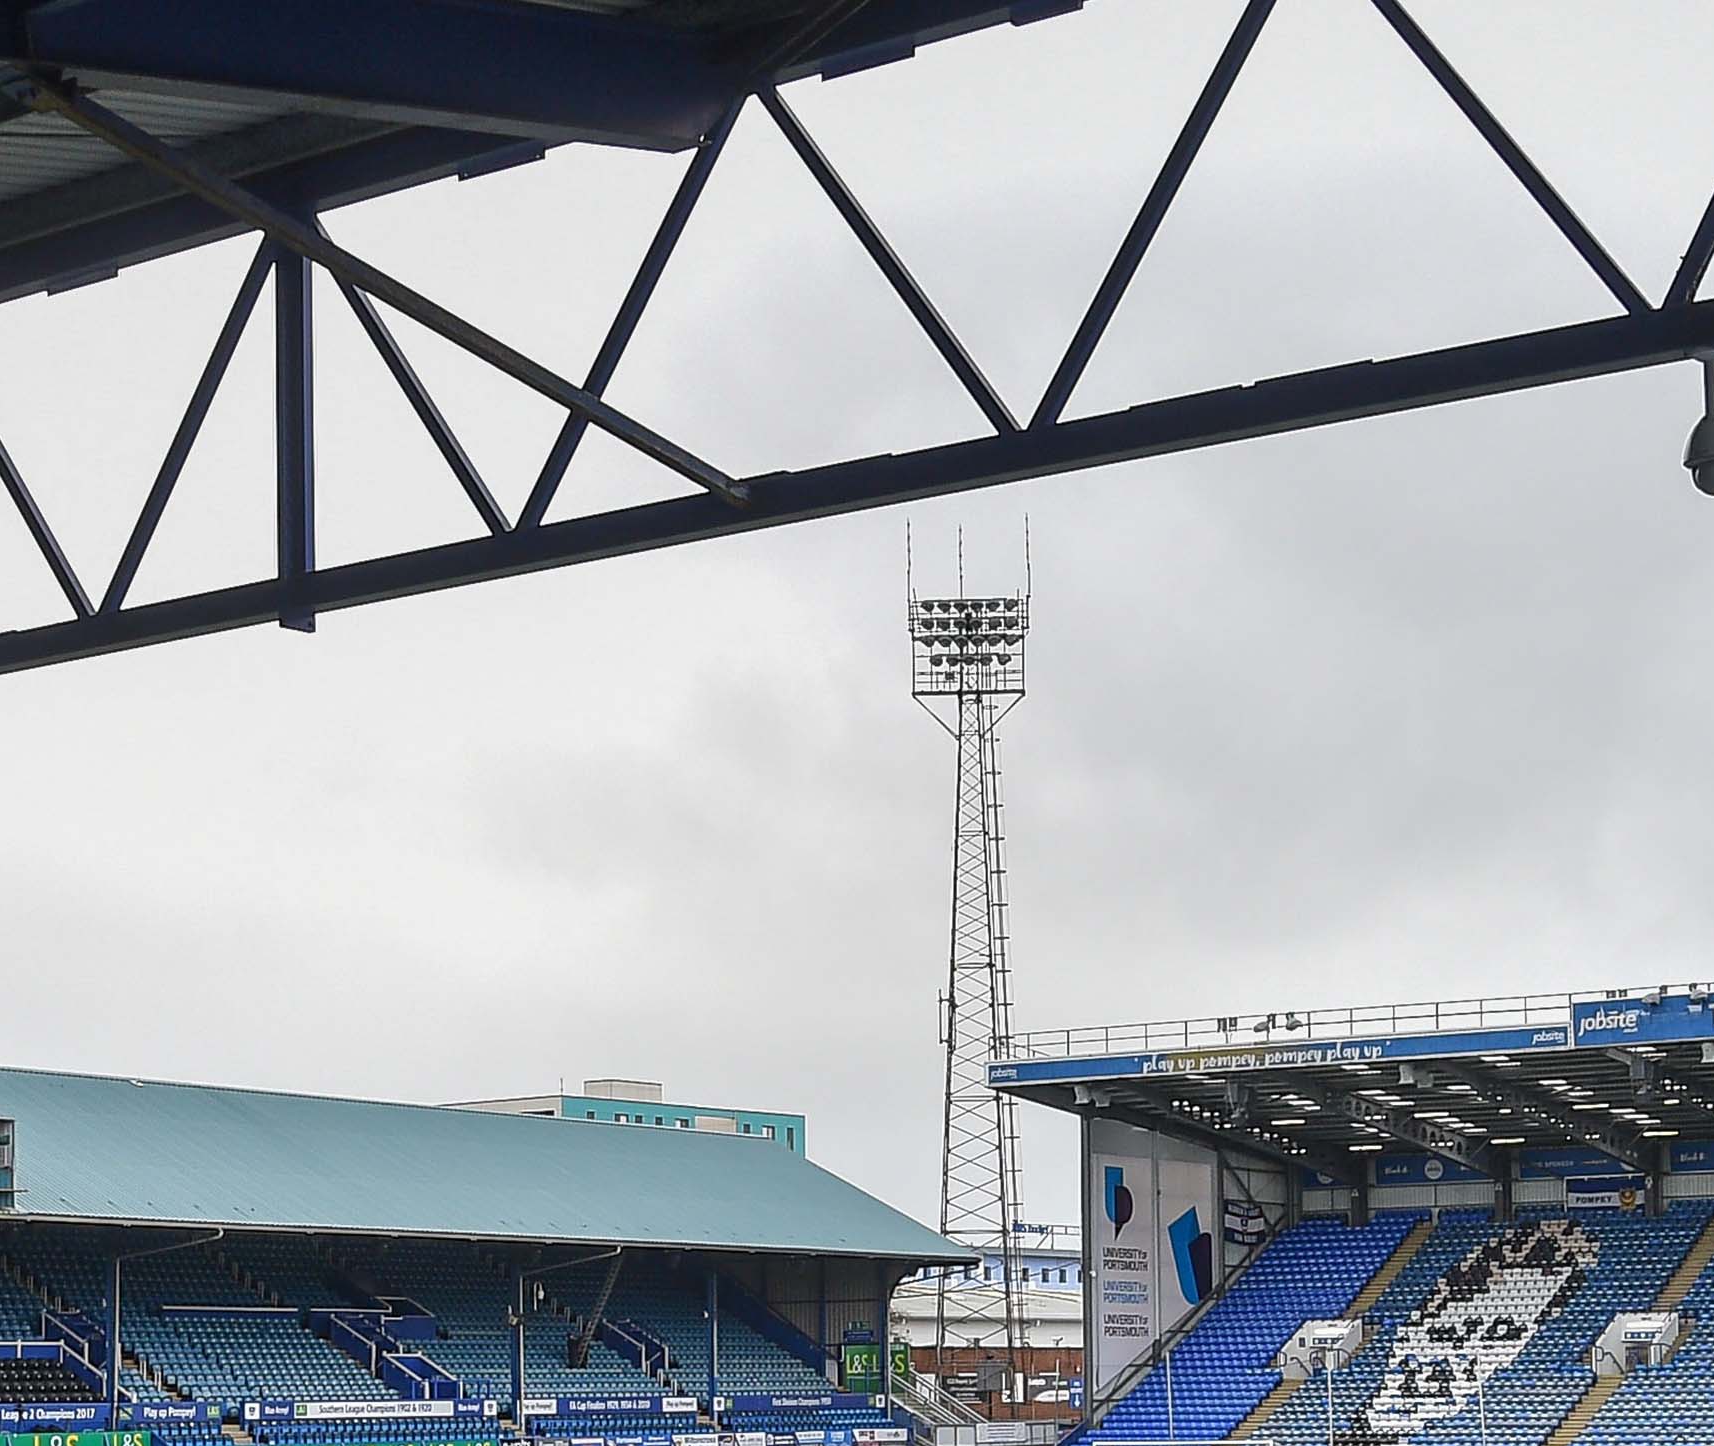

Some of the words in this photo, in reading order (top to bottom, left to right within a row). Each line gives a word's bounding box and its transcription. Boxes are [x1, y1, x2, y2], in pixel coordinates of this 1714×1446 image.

[1578, 1007, 1638, 1036] jobsite
[1143, 1055, 1174, 1074] play
[1178, 1057, 1195, 1071] up
[1198, 1055, 1261, 1071] pompey,
[1265, 1050, 1322, 1068] pompey
[1326, 1042, 1361, 1064] play
[1364, 1045, 1382, 1060] up
[1576, 1195, 1613, 1204] POMPEY
[1103, 1247, 1142, 1259] UNIVERSITY
[1103, 1260, 1149, 1271] PORTSMOUTH
[1103, 1280, 1142, 1292] UNIVERSITY
[1103, 1293, 1149, 1304] PORTSMOUTH
[1103, 1314, 1142, 1325] UNIVERSITY
[1103, 1326, 1149, 1337] PORTSMOUTH
[144, 1407, 160, 1419] Play
